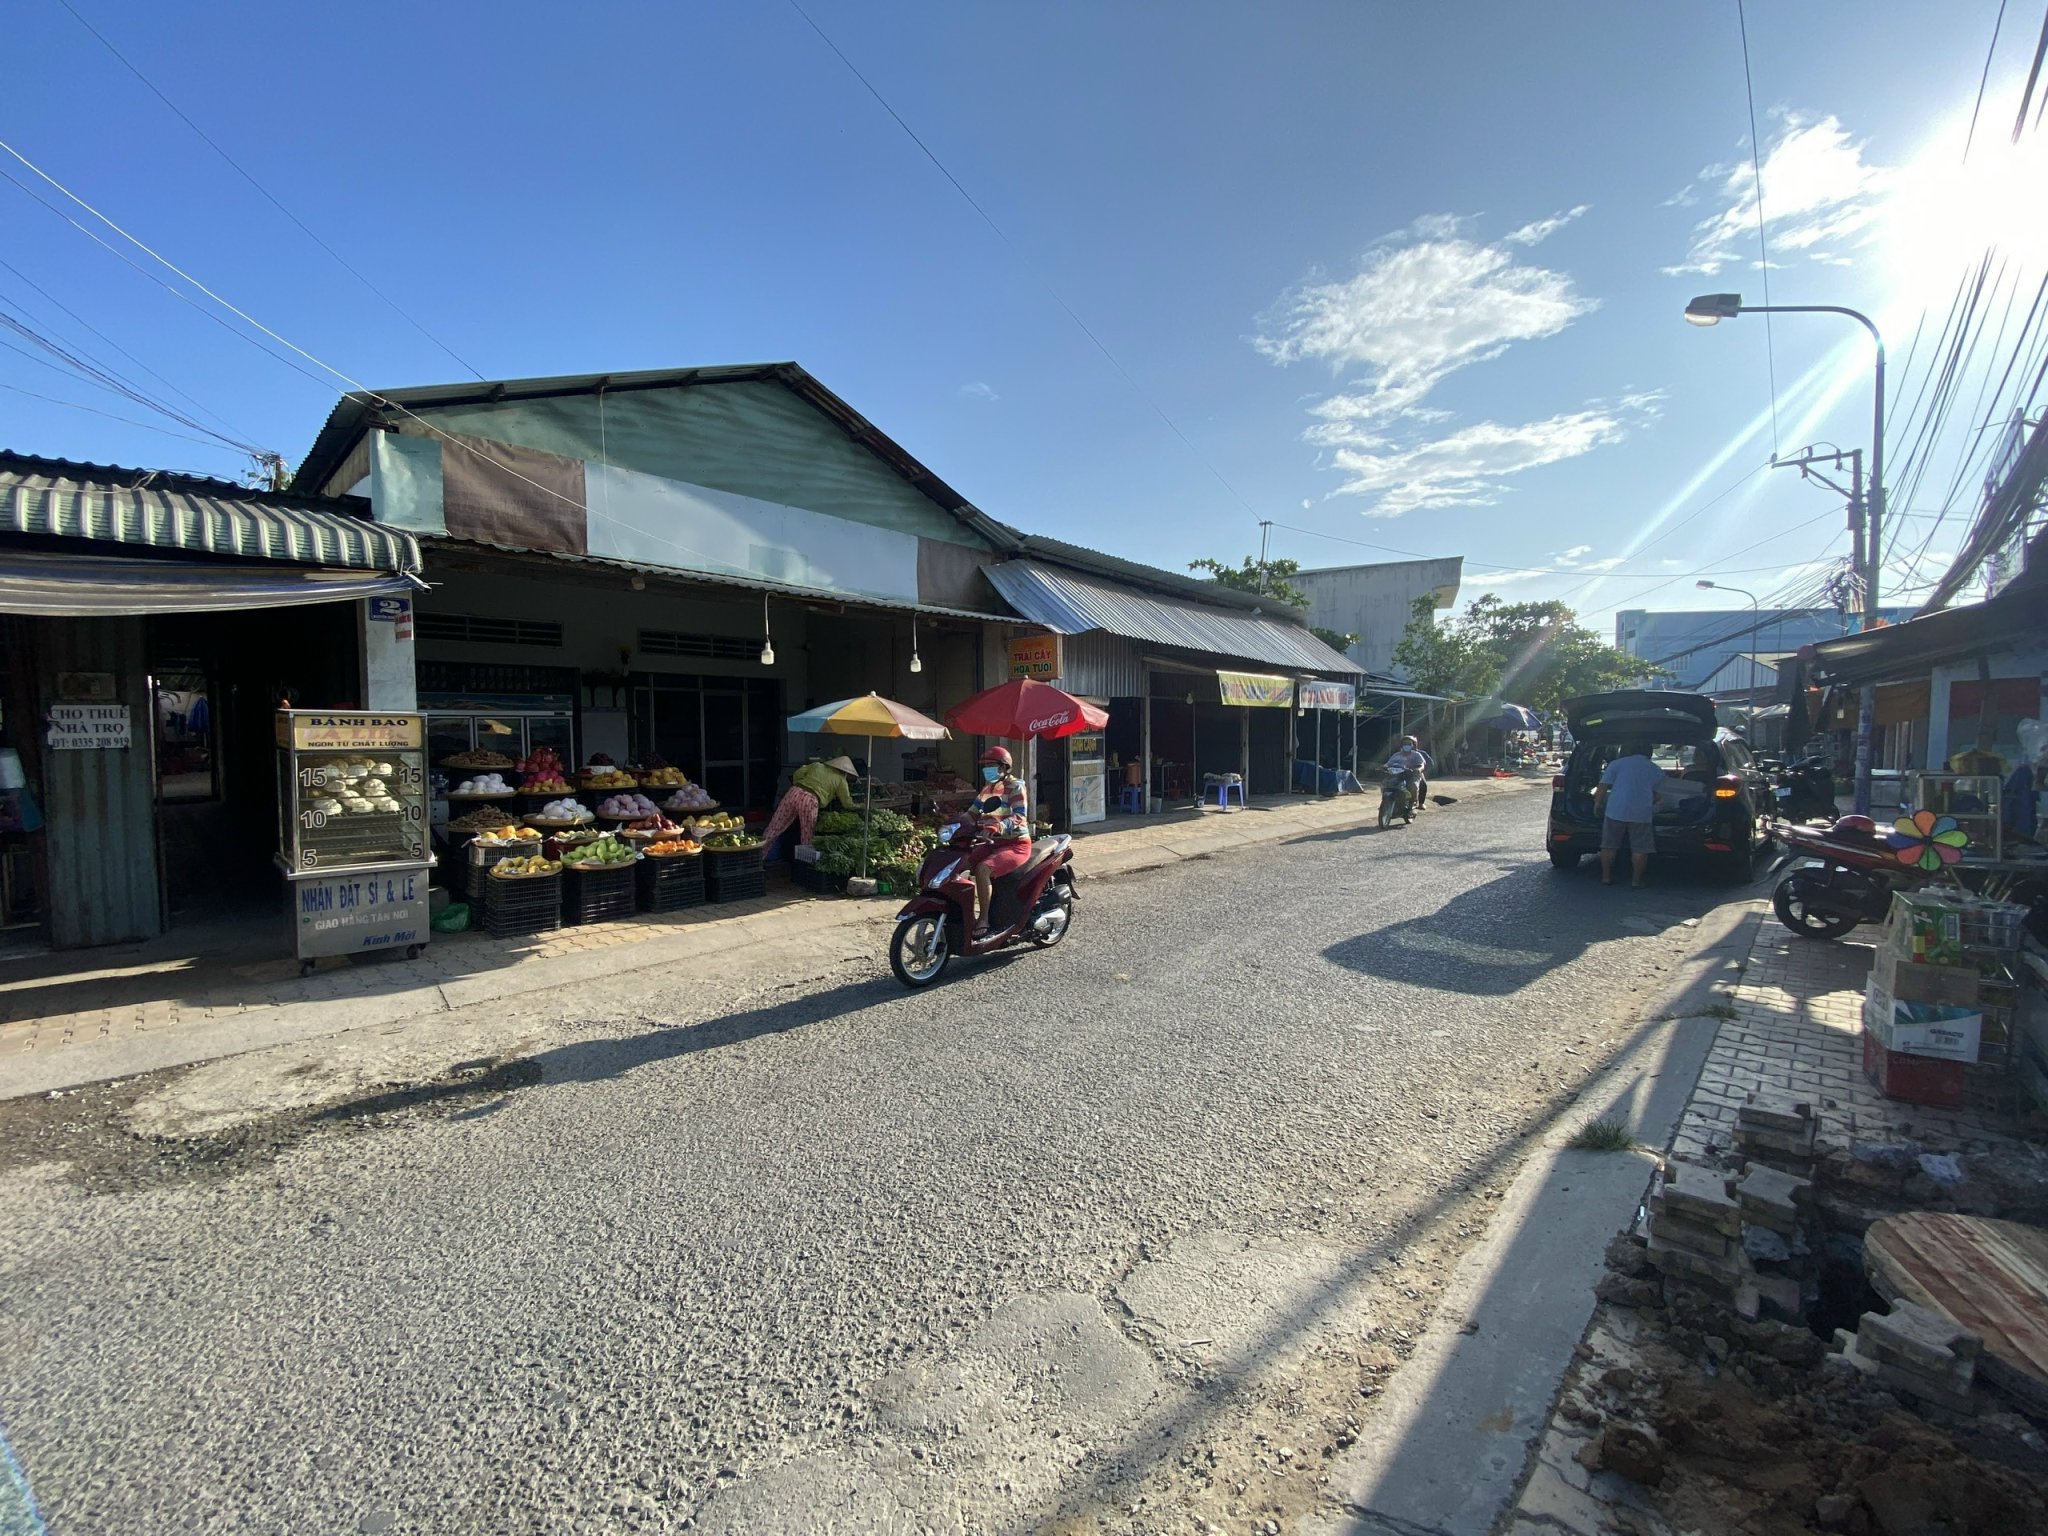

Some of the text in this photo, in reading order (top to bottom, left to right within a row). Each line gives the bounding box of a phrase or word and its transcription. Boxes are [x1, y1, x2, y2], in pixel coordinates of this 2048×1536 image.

[379, 600, 402, 615] 2
[50, 708, 83, 720] CHO
[310, 716, 408, 727] BÁNH BAO
[92, 722, 124, 735] TRỌ
[300, 768, 327, 787] 15
[400, 768, 421, 784] 15
[301, 810, 326, 829] 10
[401, 806, 421, 821] 10
[411, 842, 422, 858] 5
[302, 849, 317, 867] 5
[386, 880, 395, 902] &
[315, 918, 339, 931] GIAO
